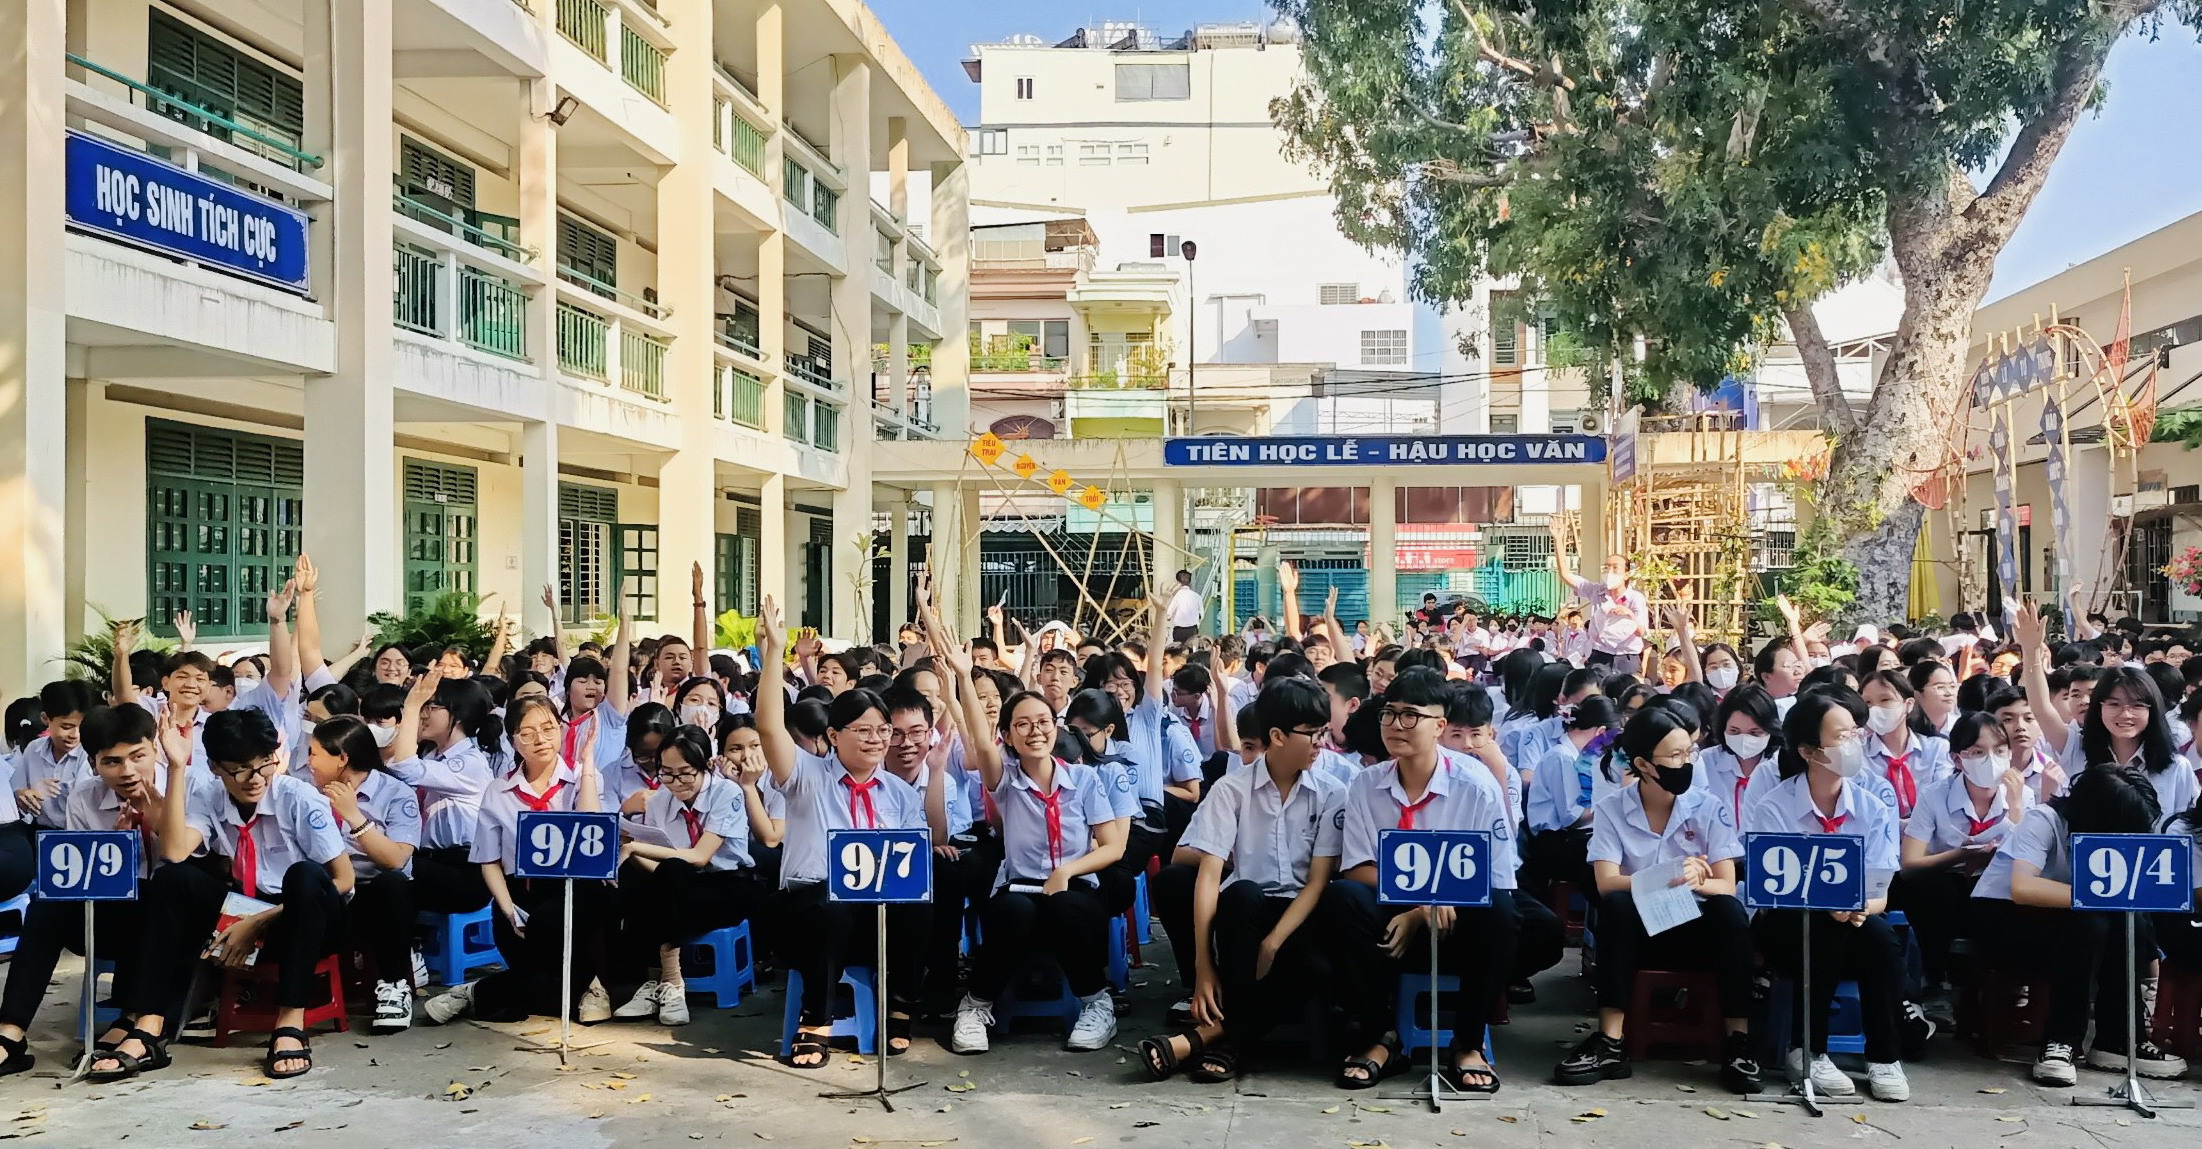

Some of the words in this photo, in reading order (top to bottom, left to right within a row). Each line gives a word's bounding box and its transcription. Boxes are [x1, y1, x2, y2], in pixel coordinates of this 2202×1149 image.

[96, 164, 140, 226] HỌC
[146, 180, 194, 238] SINH
[198, 192, 240, 252] TÍCH
[243, 215, 277, 268] CỰC
[1186, 442, 1250, 461] TIÊN
[1259, 444, 1317, 464] HỌC
[1326, 439, 1359, 460] LỄ
[1389, 441, 1448, 463] HẬU
[1457, 443, 1516, 463] HỌC
[1525, 440, 1585, 459] VĂN
[50, 841, 123, 890] 9/9
[530, 822, 604, 869] 9/8
[841, 840, 916, 892] 9/7
[1394, 841, 1476, 894] 9/6
[1762, 845, 1848, 898] 9/5
[2088, 846, 2175, 900] 9/4
